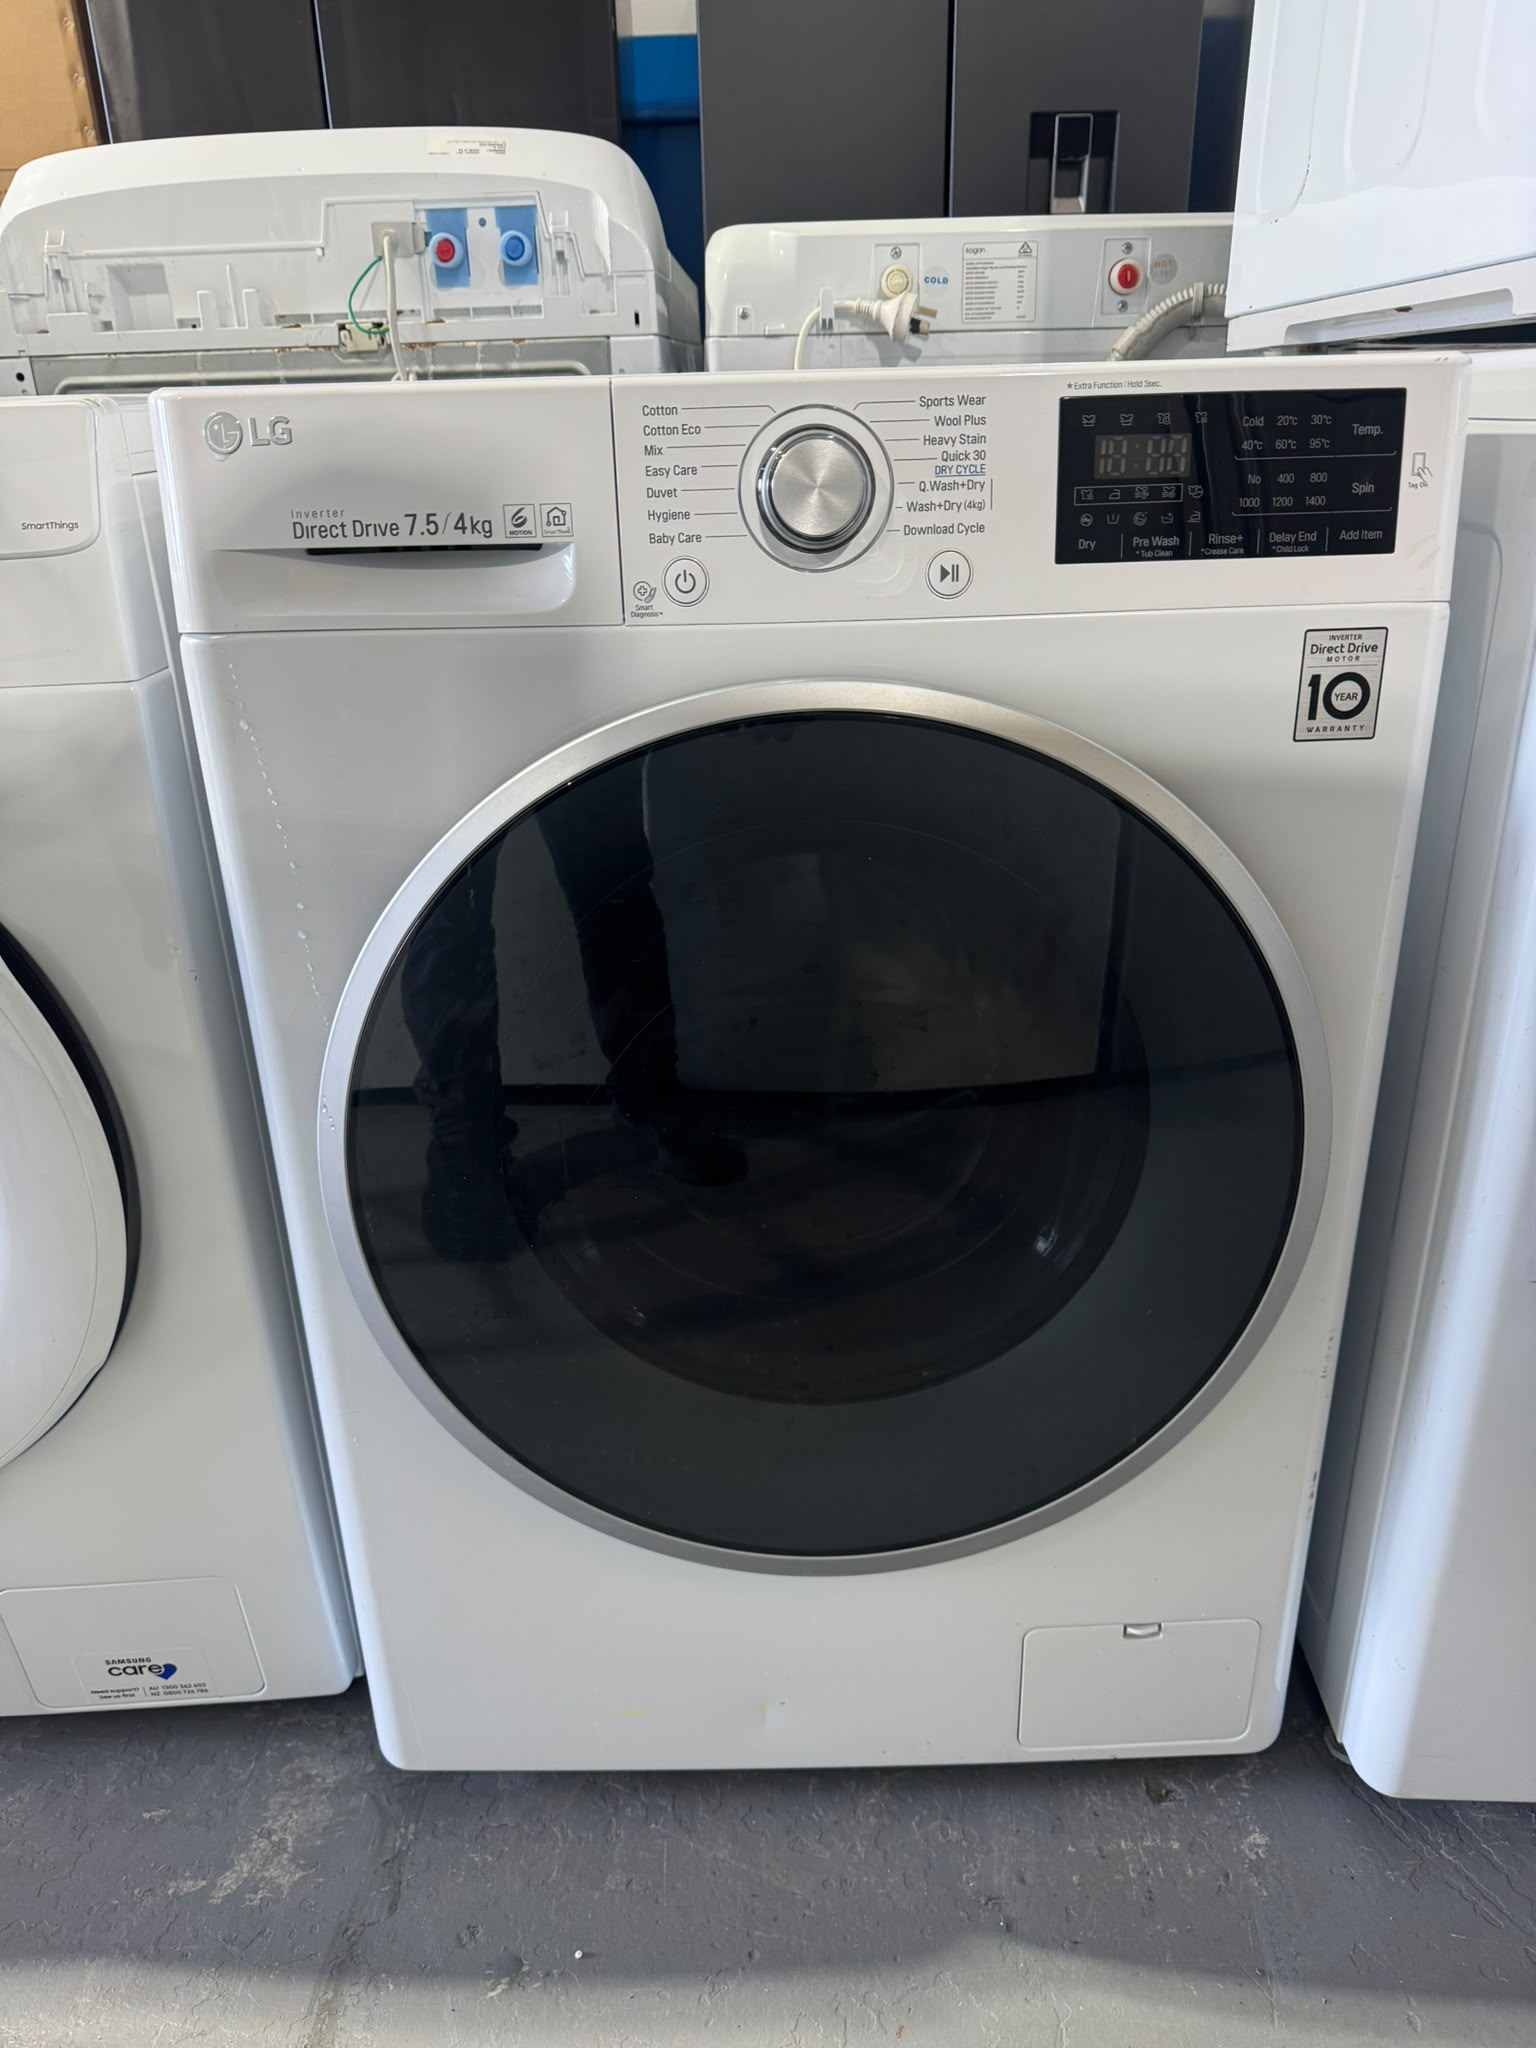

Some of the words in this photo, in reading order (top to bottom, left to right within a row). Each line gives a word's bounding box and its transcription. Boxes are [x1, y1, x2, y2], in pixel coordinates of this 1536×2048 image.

[924, 276, 949, 285] COLD
[1074, 382, 1092, 390] Extra
[1093, 381, 1123, 389] Function
[1127, 380, 1143, 388] Hold
[919, 396, 955, 409] Sports
[957, 394, 987, 406] Wear
[642, 405, 678, 416] Cotton
[934, 415, 961, 427] Wool
[963, 414, 987, 426] Plus
[1242, 416, 1264, 427] Cold
[248, 415, 293, 447] LG
[643, 425, 679, 436] Cotton
[681, 423, 701, 435] Eco
[1352, 424, 1383, 436] Temp.
[923, 435, 957, 447] Heavy
[959, 433, 987, 445] Stain
[644, 445, 664, 456] Mix
[941, 450, 971, 462] Quick
[973, 449, 987, 461] 30
[645, 465, 671, 479] Easy
[673, 465, 698, 476] Care
[934, 465, 954, 475] DRY
[955, 463, 987, 474] CYCLE
[1247, 474, 1262, 485] No
[1277, 473, 1295, 484] 400
[1310, 472, 1328, 483] 800
[646, 487, 678, 498] Duvet
[919, 480, 986, 493] Q.Wash+Dry
[1352, 482, 1375, 495] Spin
[906, 500, 962, 513] Wash+Dry
[963, 499, 986, 511] (4kg)
[1239, 497, 1260, 508] 1000
[1272, 496, 1294, 507] 1200
[1305, 495, 1327, 506] 1400
[290, 509, 345, 519] Inverter
[647, 509, 691, 523] Hygiene
[21, 521, 79, 531] SmartThings
[292, 521, 348, 539] Direct
[352, 519, 400, 538] Drive
[903, 525, 955, 536] Download
[956, 522, 986, 536] Cycle
[649, 532, 675, 546] Baby
[677, 532, 702, 543] Care
[1133, 537, 1149, 547] Pre
[1151, 536, 1180, 546] Wash
[1208, 533, 1244, 545] Rinse+
[1269, 532, 1297, 544] Delay
[1298, 531, 1318, 542] End
[1339, 530, 1359, 541] Add
[1361, 530, 1384, 540] Item
[1078, 539, 1097, 550] Dry
[1310, 643, 1346, 655] Direct
[1347, 642, 1379, 653] Drive
[1326, 655, 1361, 663] MOTOR
[1307, 671, 1371, 721] 10
[1334, 692, 1359, 702] YEAR
[1306, 725, 1365, 733] WARRANTY
[105, 1657, 152, 1666] SAMSUNG
[107, 1664, 163, 1677] care
